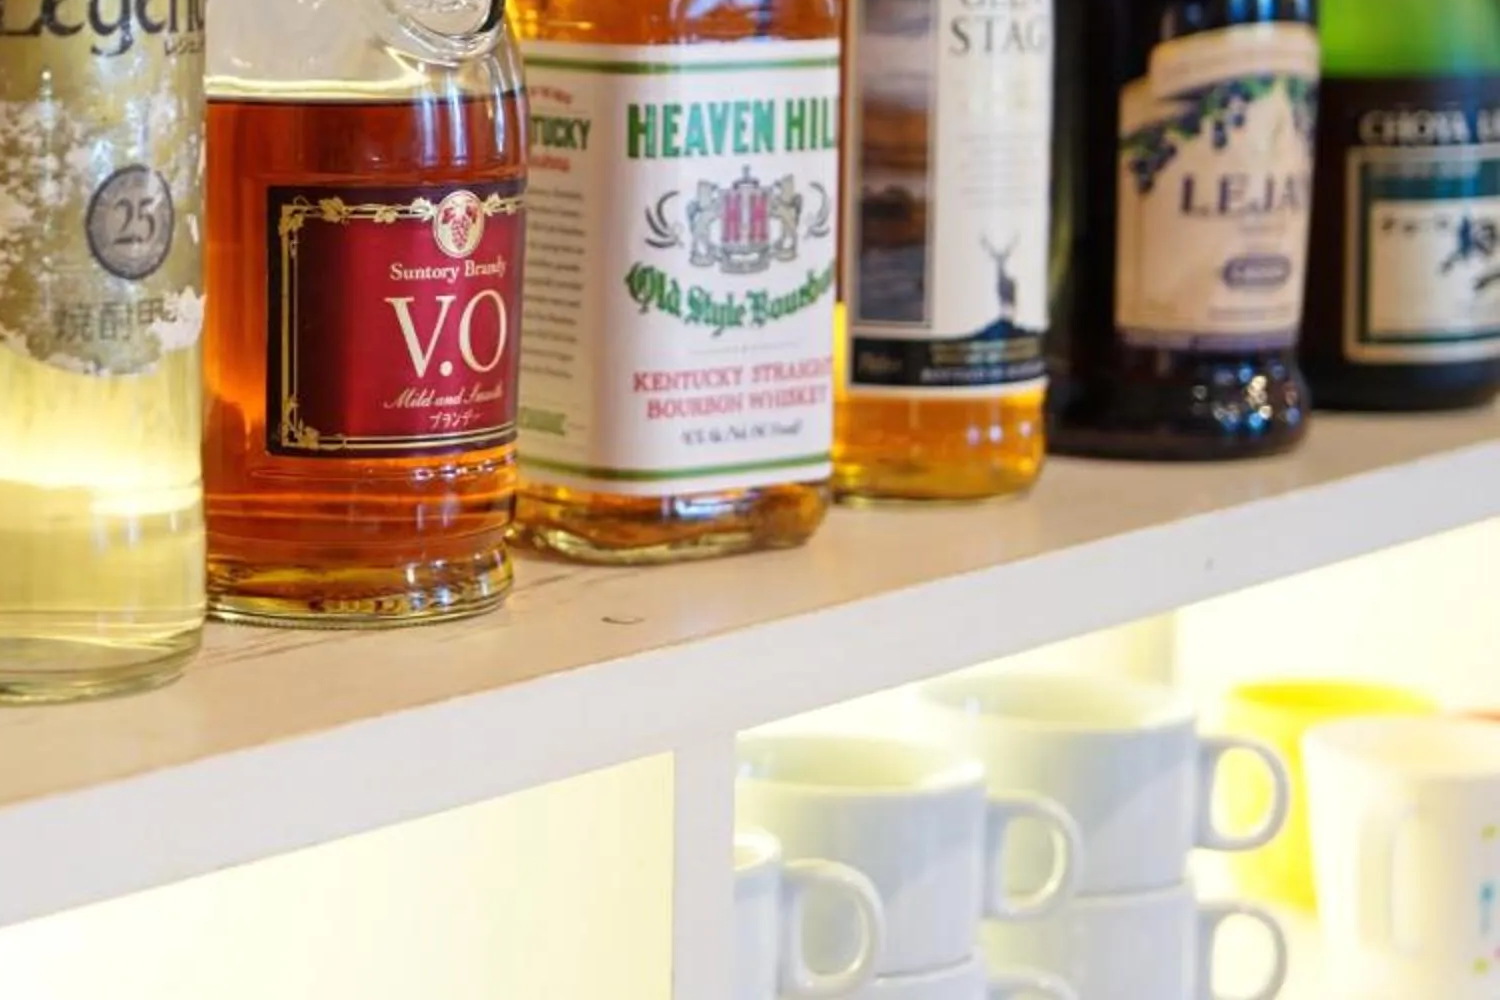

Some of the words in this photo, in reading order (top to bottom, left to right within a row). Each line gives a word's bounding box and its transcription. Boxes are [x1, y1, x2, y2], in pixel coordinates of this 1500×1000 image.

[948, 14, 1048, 57] STAG
[530, 114, 592, 152] TUCKY
[627, 100, 775, 158] HEAVEN
[784, 96, 837, 152] HIL
[114, 197, 156, 245] 25
[389, 263, 459, 284] Suntory
[464, 256, 507, 278] Brandy
[384, 289, 508, 379] V.O
[632, 365, 743, 394] KENTUCKY
